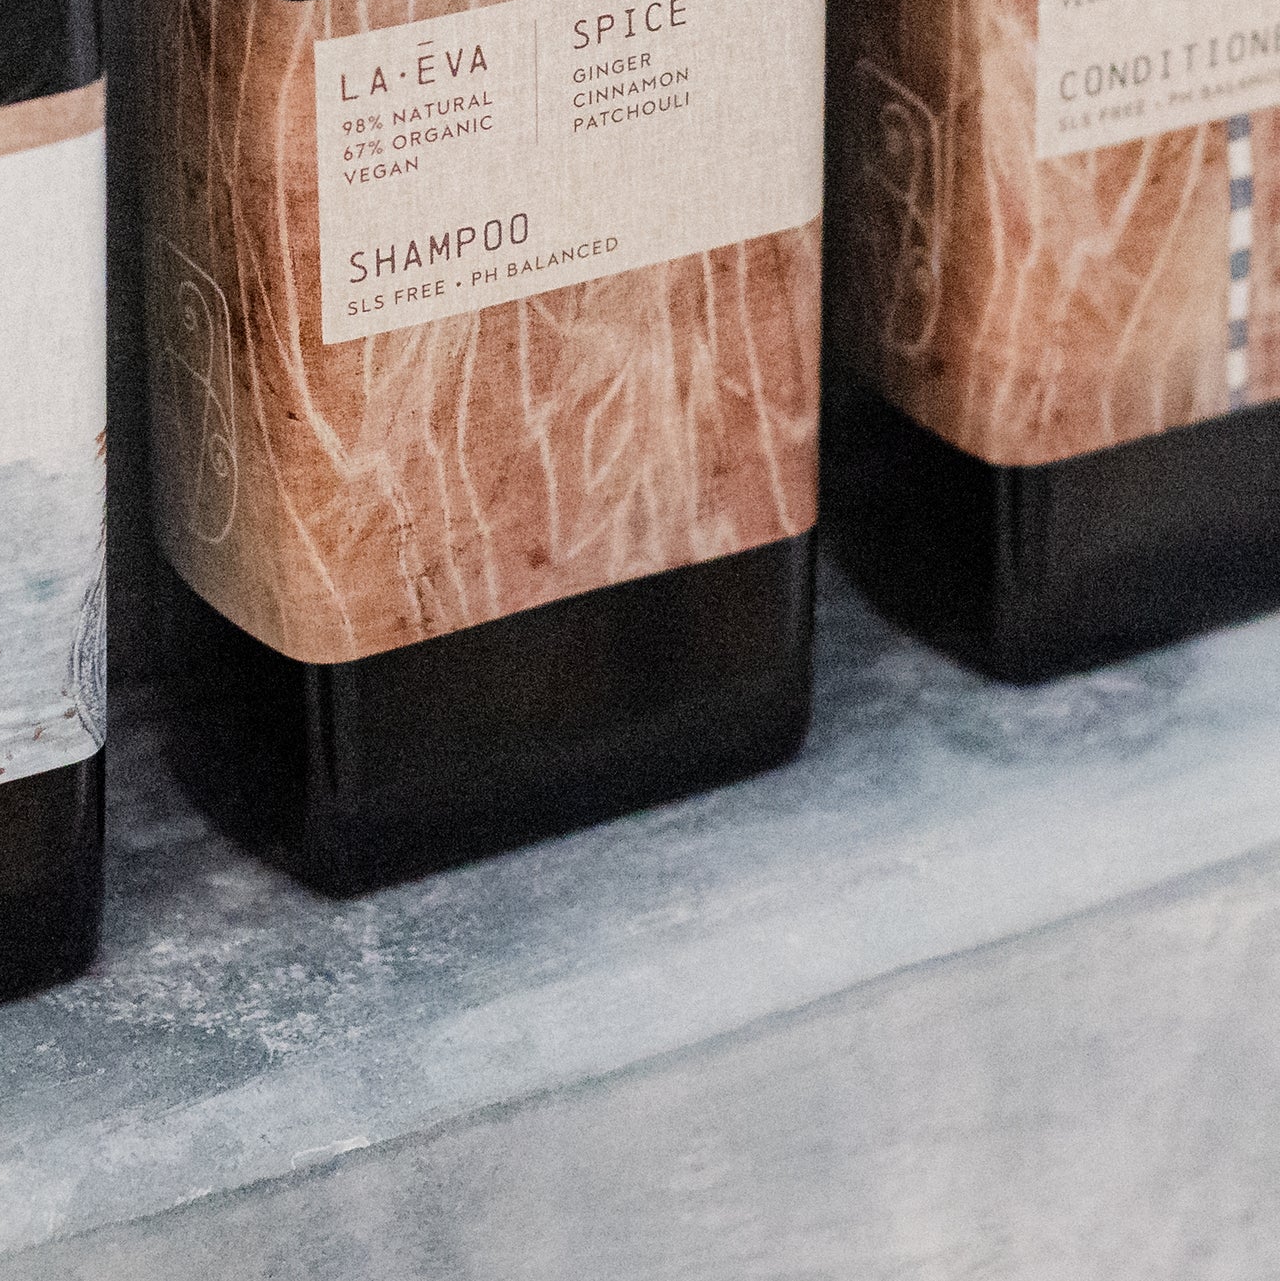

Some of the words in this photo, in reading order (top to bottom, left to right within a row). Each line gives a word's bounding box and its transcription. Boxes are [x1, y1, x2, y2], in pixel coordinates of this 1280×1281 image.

[572, 52, 652, 84] GINGER
[572, 67, 690, 108] CINNAMON
[342, 113, 383, 137] 98%
[392, 90, 494, 126] NATURAL
[572, 91, 691, 133] PATCHOULI
[1099, 98, 1146, 121] FREE
[343, 138, 384, 162] 67%
[392, 114, 494, 151] ORGANIC
[344, 156, 420, 186] VEGAN
[349, 212, 530, 284] SHAMPOO
[347, 294, 385, 317] SLS
[394, 278, 446, 306] FREE
[471, 264, 498, 287] PH
[506, 236, 619, 278] BALANCED
